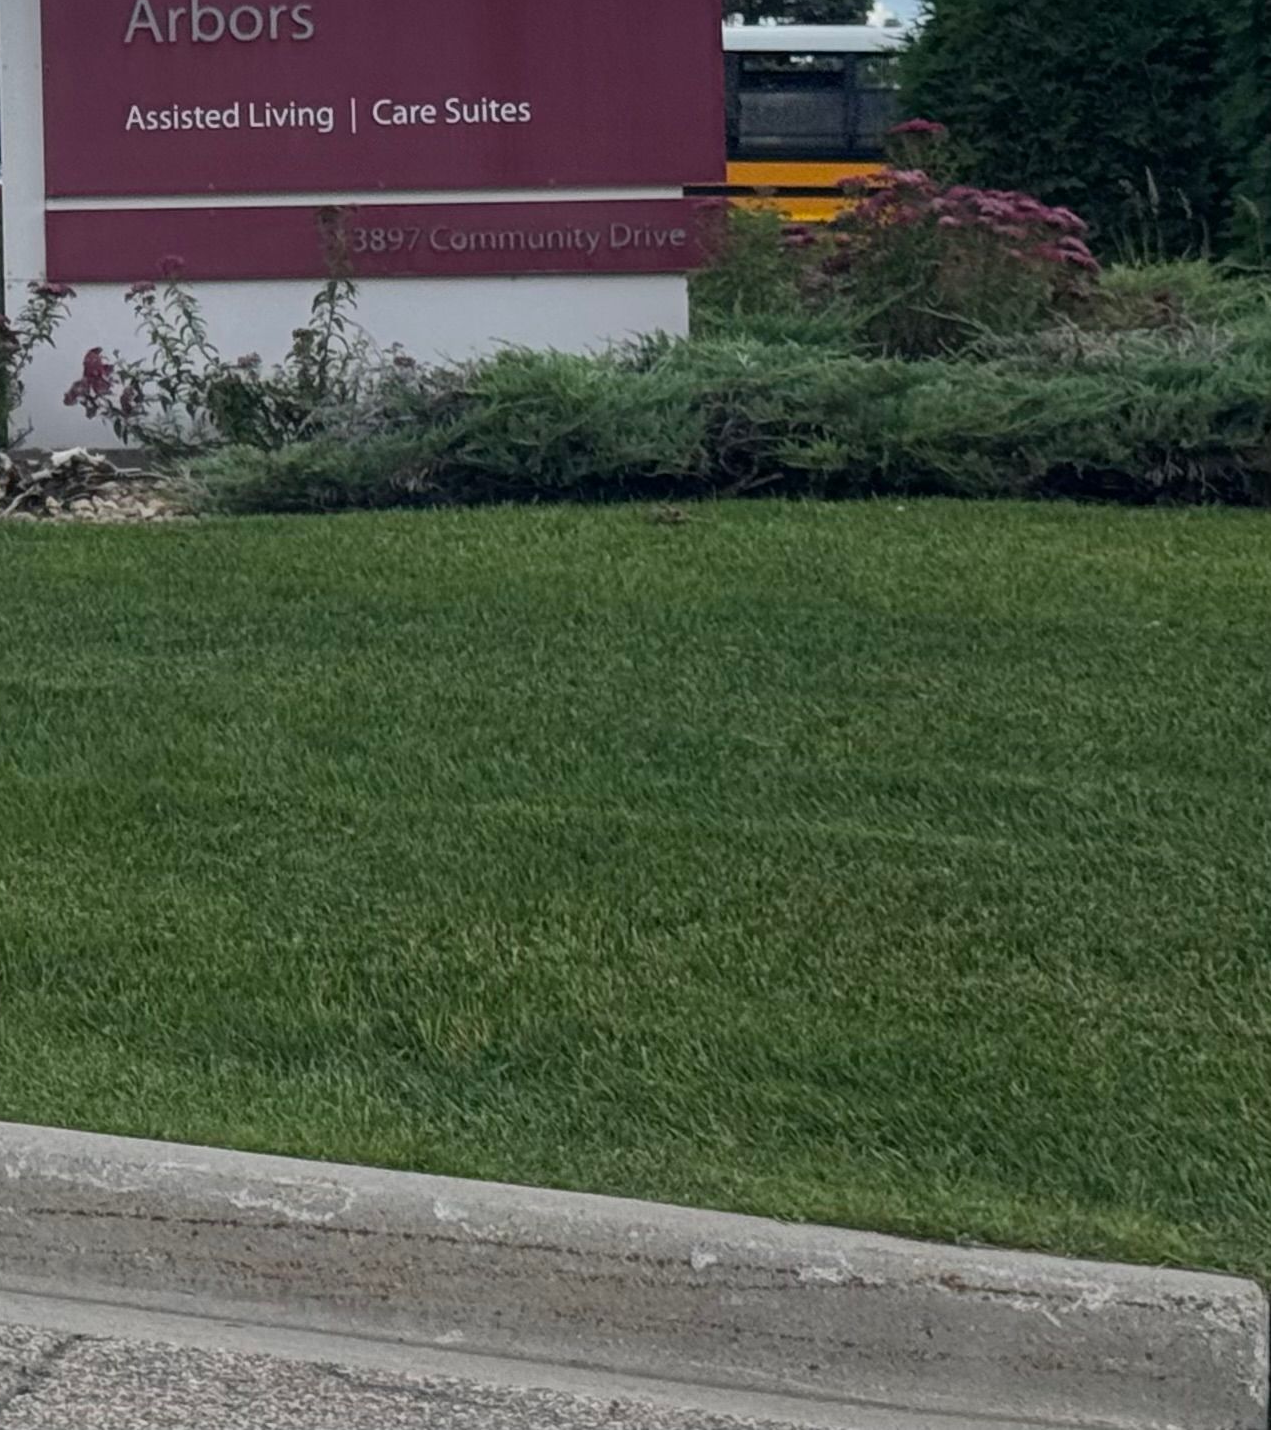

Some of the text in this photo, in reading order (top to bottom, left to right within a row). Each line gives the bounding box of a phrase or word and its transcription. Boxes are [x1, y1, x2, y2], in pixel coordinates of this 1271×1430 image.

[125, 97, 532, 133] Assisted Living Care Suites
[353, 222, 687, 255] 3897 Community Drive
